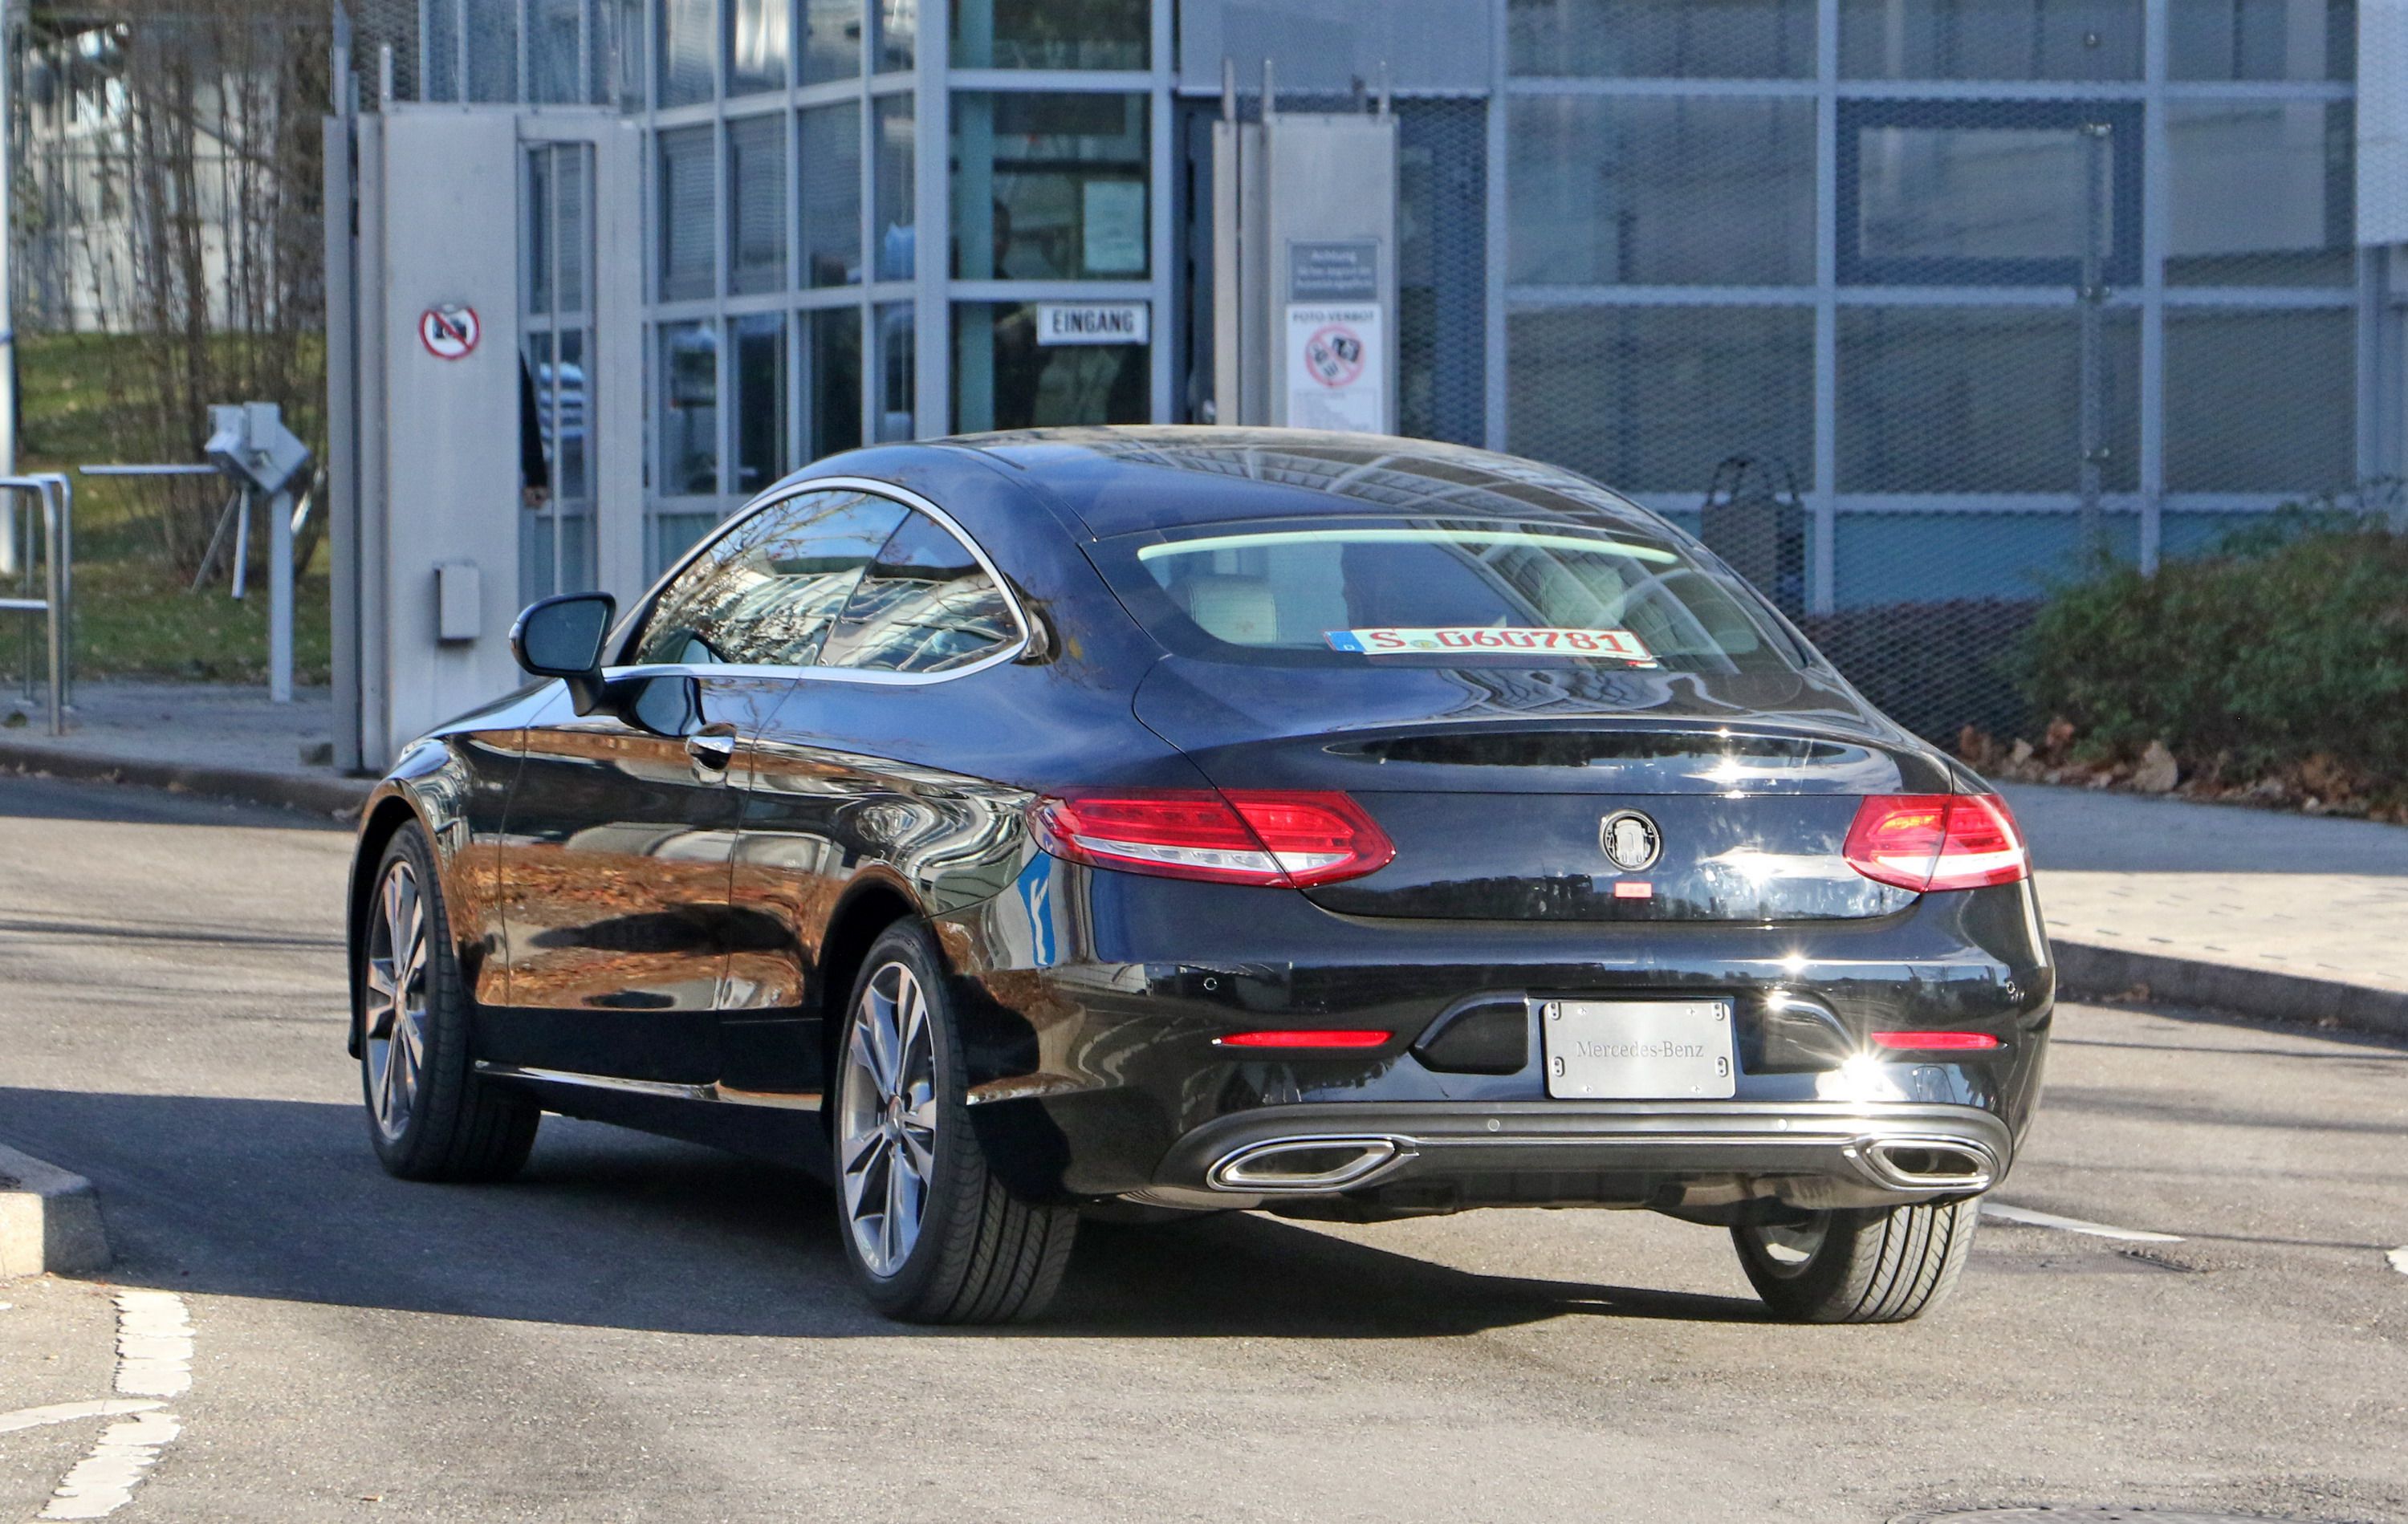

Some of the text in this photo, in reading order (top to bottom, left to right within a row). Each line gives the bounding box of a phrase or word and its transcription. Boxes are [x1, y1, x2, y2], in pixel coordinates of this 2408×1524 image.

[1052, 308, 1135, 333] EINGANG
[1369, 632, 1406, 648] S
[1434, 630, 1635, 653] 060781
[1576, 1040, 1704, 1059] Mercedes-Benz
